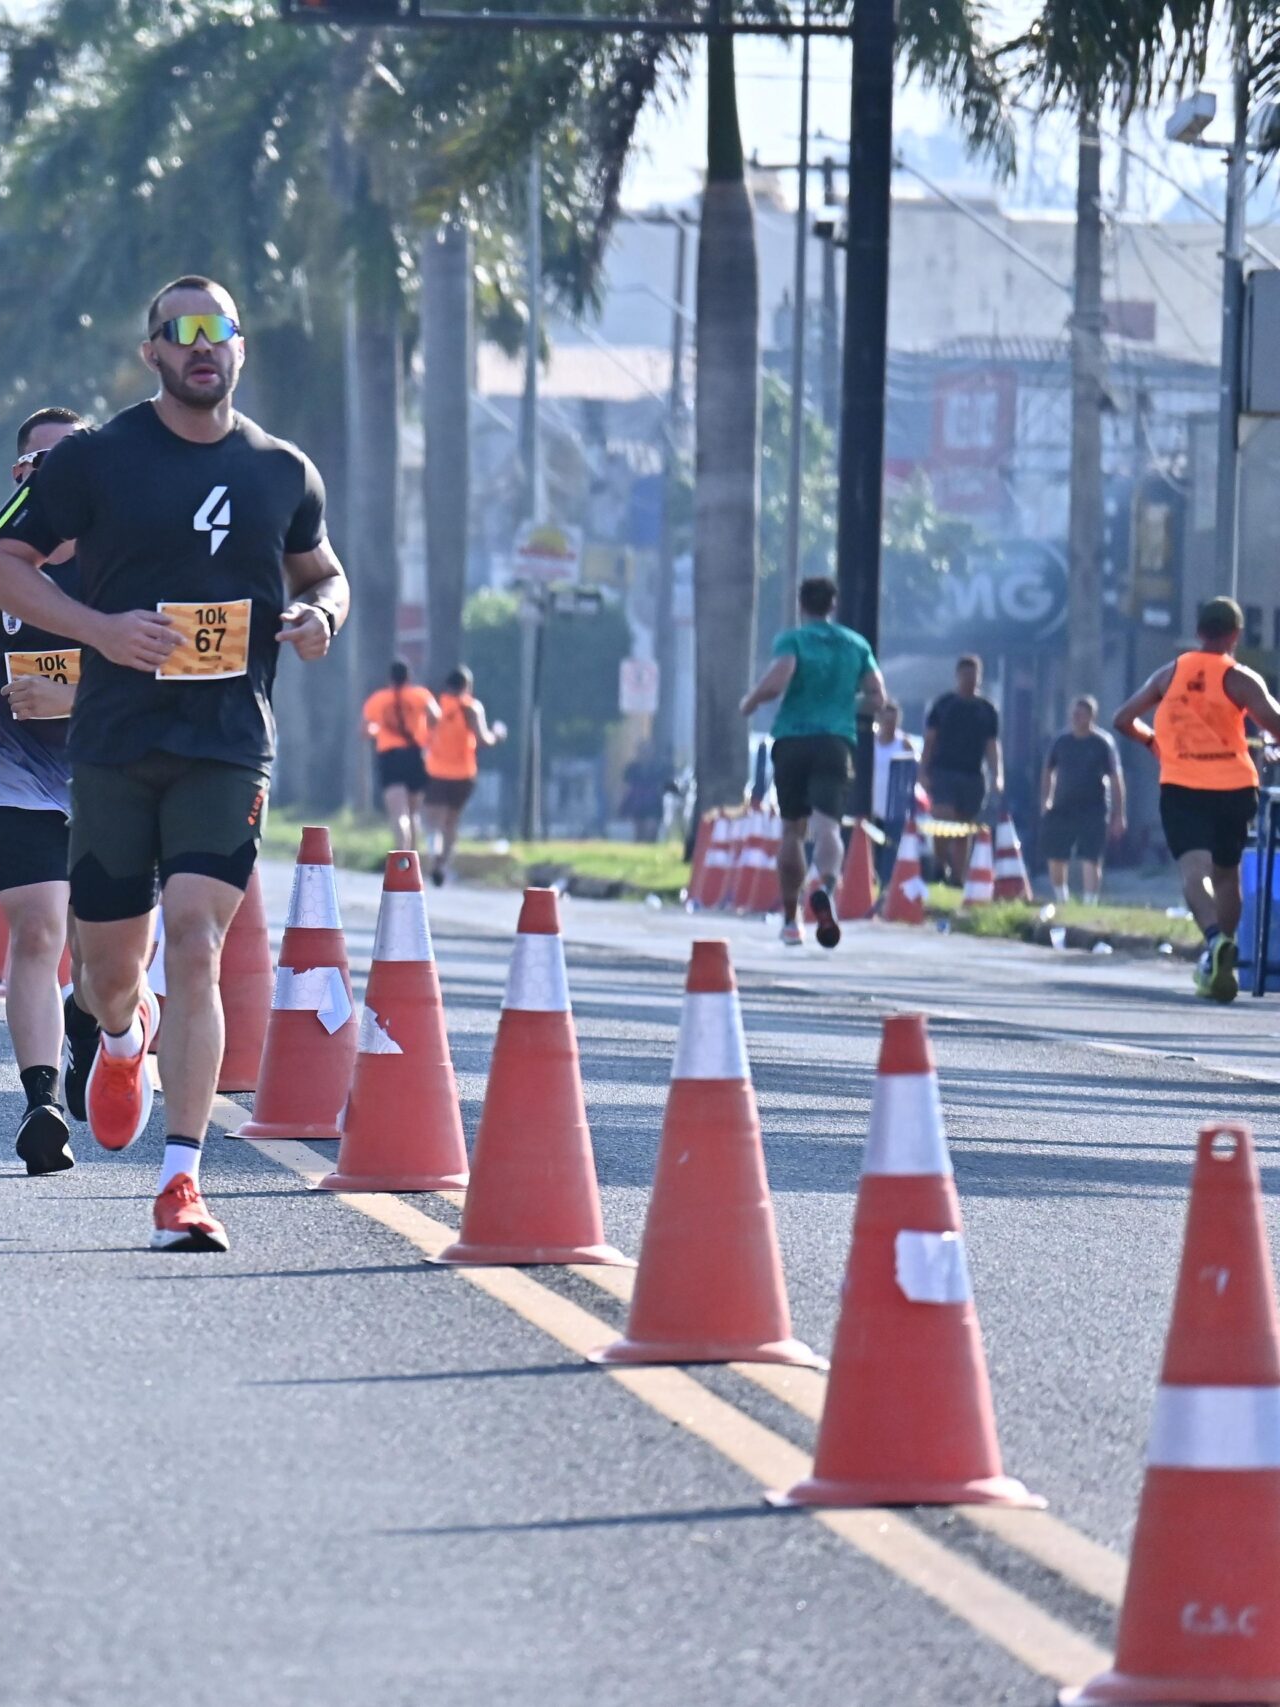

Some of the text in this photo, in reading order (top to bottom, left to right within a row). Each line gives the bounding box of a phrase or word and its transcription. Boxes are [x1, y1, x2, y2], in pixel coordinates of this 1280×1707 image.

[195, 607, 227, 625] 10k
[195, 628, 226, 653] 67
[35, 655, 67, 672] 10k
